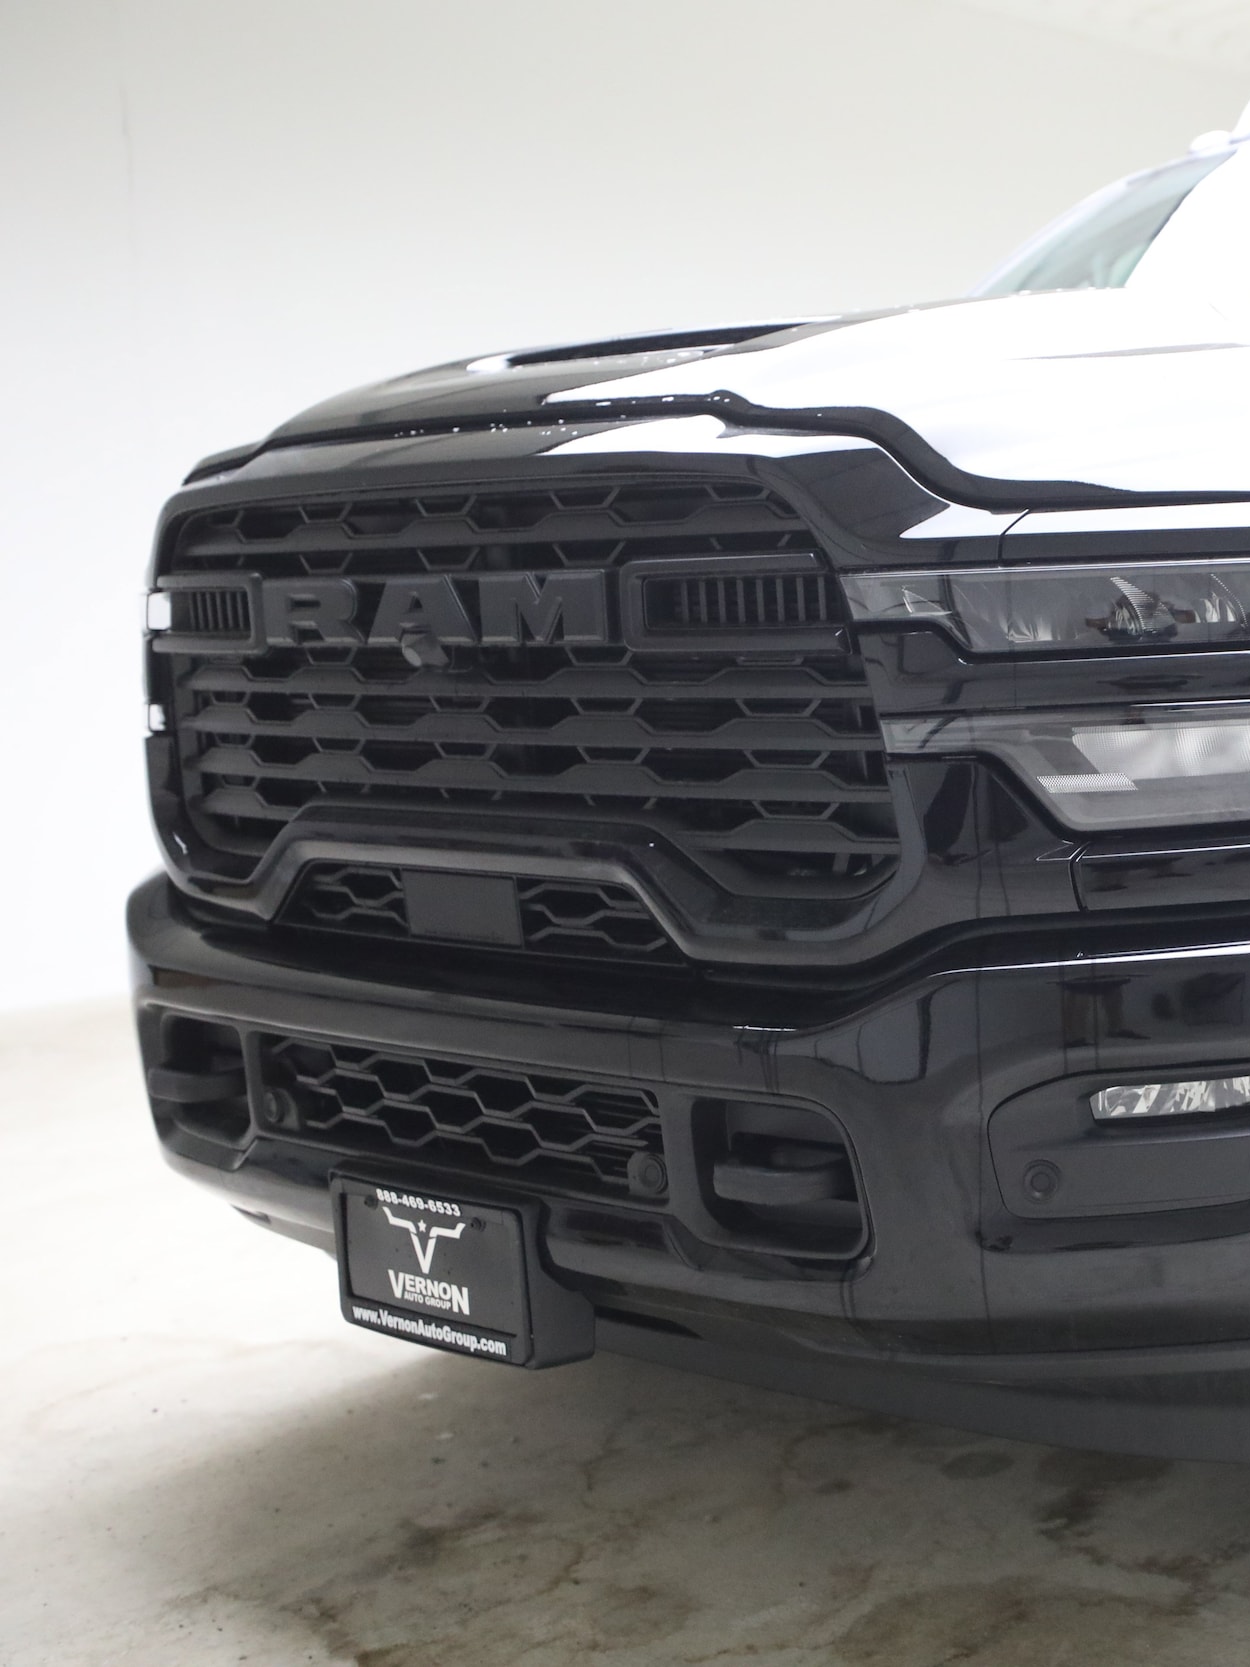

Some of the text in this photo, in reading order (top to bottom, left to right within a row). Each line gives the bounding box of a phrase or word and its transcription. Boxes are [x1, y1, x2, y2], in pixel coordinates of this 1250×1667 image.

[263, 568, 607, 645] RAM
[376, 1188, 461, 1217] 888-469-6533
[388, 1269, 469, 1315] VERNON
[404, 1291, 451, 1310] AUTO GROUP
[352, 1305, 507, 1356] www.VernonAutoGroup.com
